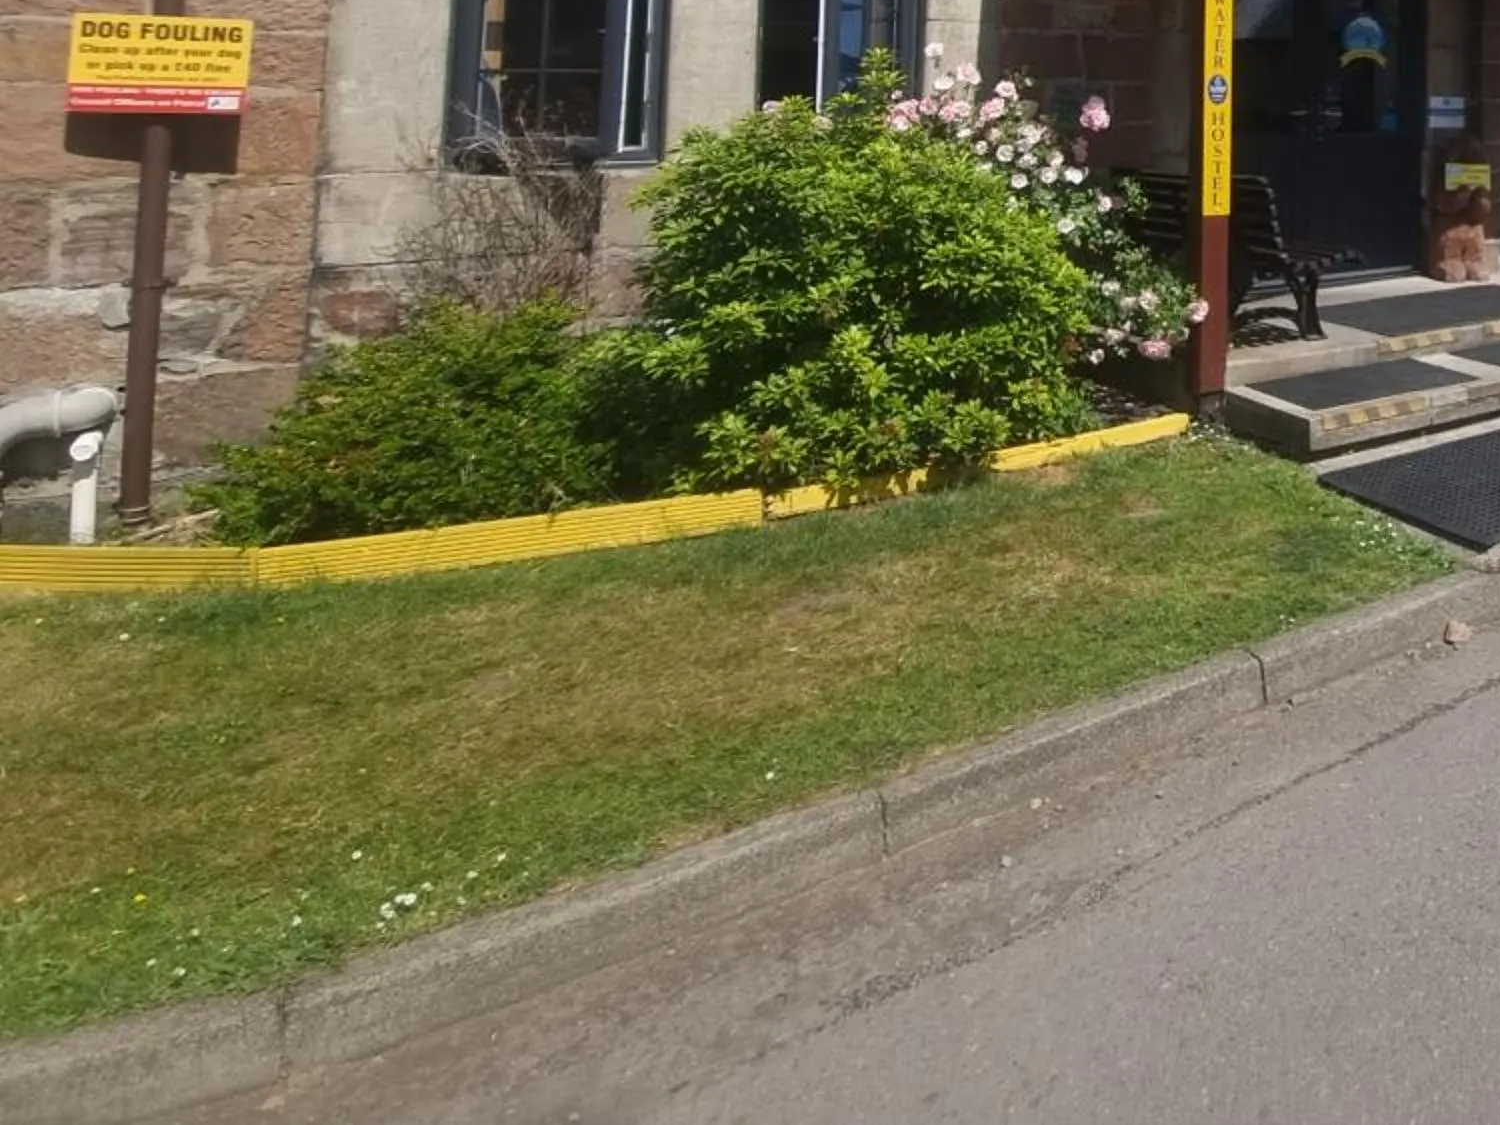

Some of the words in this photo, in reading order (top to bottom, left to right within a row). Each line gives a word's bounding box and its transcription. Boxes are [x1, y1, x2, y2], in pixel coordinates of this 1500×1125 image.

[80, 20, 131, 39] DOG
[140, 22, 243, 44] FOULING
[78, 43, 120, 54] Clean
[123, 46, 140, 56] up
[144, 45, 178, 56] after
[184, 48, 212, 59] your
[216, 48, 242, 59] dog
[86, 61, 100, 70] or
[105, 60, 134, 71] pick
[140, 61, 156, 72] up
[160, 63, 170, 72] a
[205, 62, 231, 73] fine
[1211, 111, 1226, 206] HOSTEL
